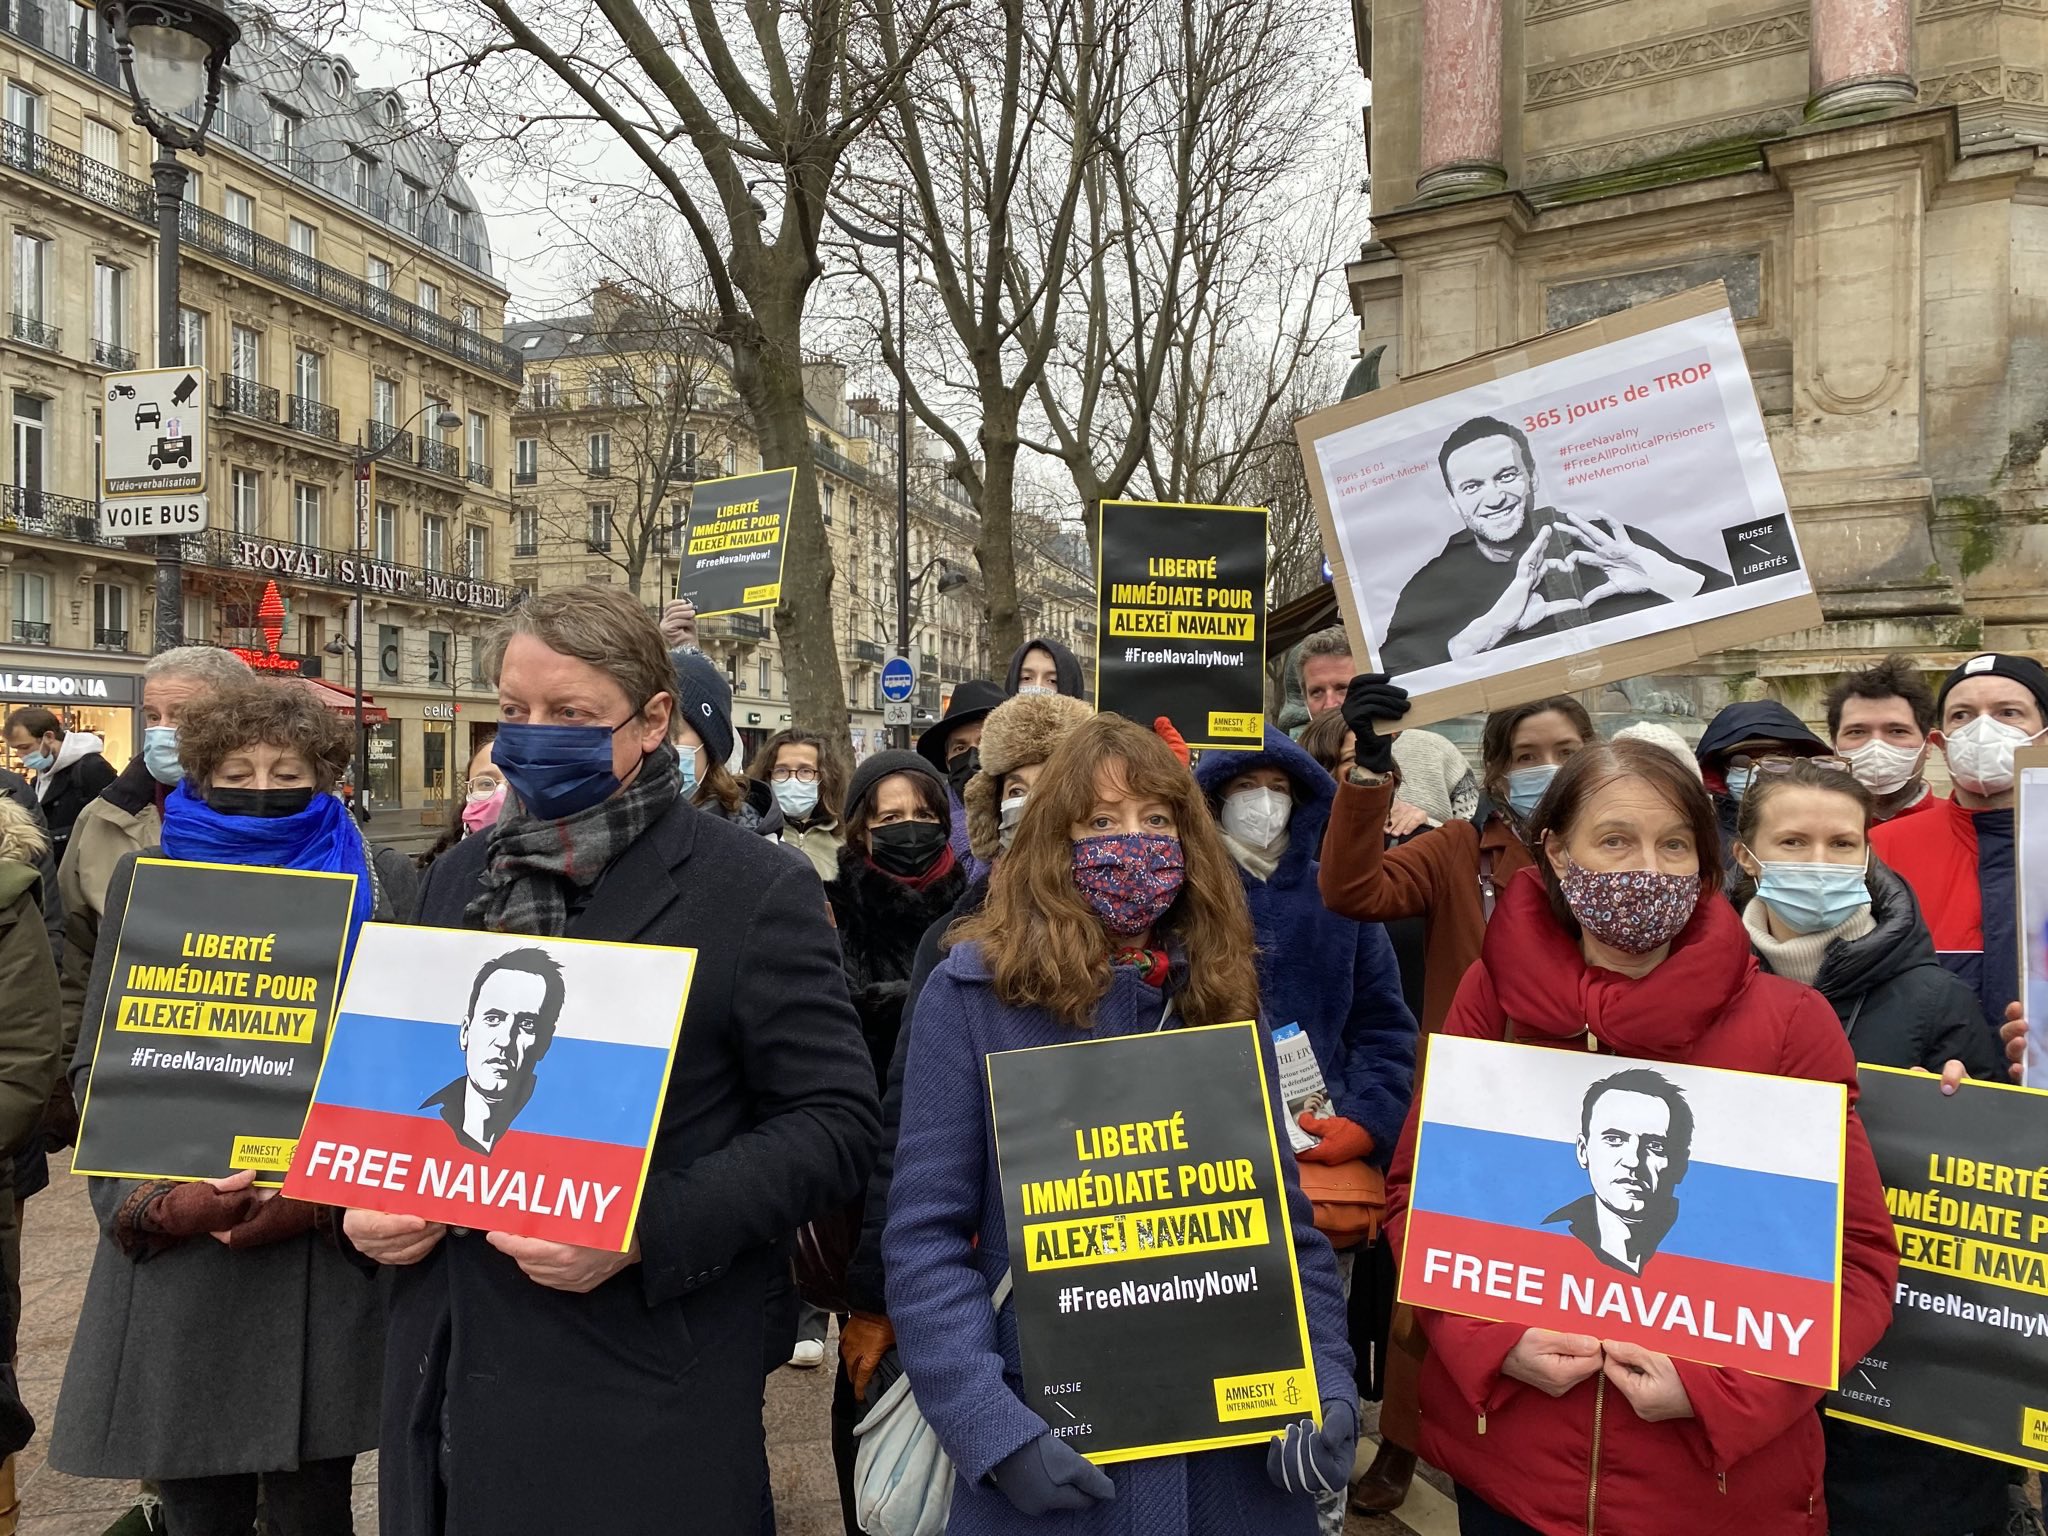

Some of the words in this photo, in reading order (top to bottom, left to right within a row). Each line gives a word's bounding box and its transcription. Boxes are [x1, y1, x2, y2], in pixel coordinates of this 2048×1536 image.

[1523, 408, 1562, 433] 365
[1566, 394, 1618, 424] jours
[1623, 384, 1650, 403] de
[1653, 362, 1712, 393] TROP
[1559, 425, 1640, 456] #FreeNavalny
[1336, 472, 1359, 485] Paris
[1341, 486, 1357, 497] 14h
[1372, 461, 1429, 487] Saint-Michel
[1567, 455, 1650, 486] #WeMemorial
[109, 476, 197, 492] Vidéo-verbalisation
[107, 506, 153, 527] VOIE
[160, 503, 200, 525] BUS
[716, 498, 760, 519] LIBERTÉ
[692, 518, 748, 537] IMMÉDIATE
[750, 513, 780, 529] POUR
[1738, 524, 1774, 541] RUSSIE
[692, 532, 727, 553] ALEXEÏ
[729, 529, 776, 546] NAVALNY
[241, 540, 328, 579] ROYAL
[695, 549, 771, 569] #FreeNavalnyNow!
[1149, 555, 1218, 579] LIBERTÉ
[1742, 555, 1788, 575] LIBERTÉS
[1111, 581, 1203, 607] IMMÉDIATE
[1207, 588, 1253, 609] POUR
[1114, 611, 1173, 633] ALEXEÏ
[1177, 615, 1248, 636] NAVALNY
[1125, 647, 1245, 668] #FreeNavalnyNow!
[1213, 717, 1244, 727] AMNESTY
[182, 932, 276, 962] LIBERTÉ
[126, 963, 250, 998] IMMÉDIATE
[254, 974, 318, 1002] POUR
[124, 1002, 206, 1031] ALEXEÏ
[208, 1007, 307, 1037] NAVALNY
[130, 1047, 294, 1077] #FreeNavalnyNow!
[1290, 1086, 1309, 1096] France
[1075, 1110, 1190, 1162] LIBERTÉ
[238, 1156, 280, 1165] INTERNATIONAL
[239, 1144, 282, 1157] AMNESTY
[305, 1140, 412, 1192] FREE
[416, 1158, 623, 1224] NAVALNY
[1021, 1167, 1174, 1217] IMMÉDIATE
[1178, 1157, 1258, 1198] POUR
[1928, 1153, 2048, 1202] LIBERTÉ
[1882, 1185, 2022, 1241] MMÉDIATE
[1034, 1214, 1127, 1264] ALEXEÏ
[1134, 1206, 1254, 1253] NAVALNY
[1901, 1232, 1967, 1271] EXEÏ
[1973, 1246, 2048, 1289] NAVA
[1058, 1265, 1259, 1315] #FreeNavalnyNow!
[1422, 1247, 1546, 1306] FREE
[1558, 1273, 1816, 1357] NAVALNY
[1894, 1282, 2048, 1338] FreeNavalnyN
[1857, 1356, 1889, 1370] USSIE
[1044, 1381, 1082, 1396] RUSSIE
[1225, 1382, 1276, 1402] AMNESTY
[1842, 1388, 1892, 1408] LIBERTÉS
[1226, 1398, 1279, 1413] INTERNATIONAL
[1049, 1422, 1093, 1439] IBERTÉS
